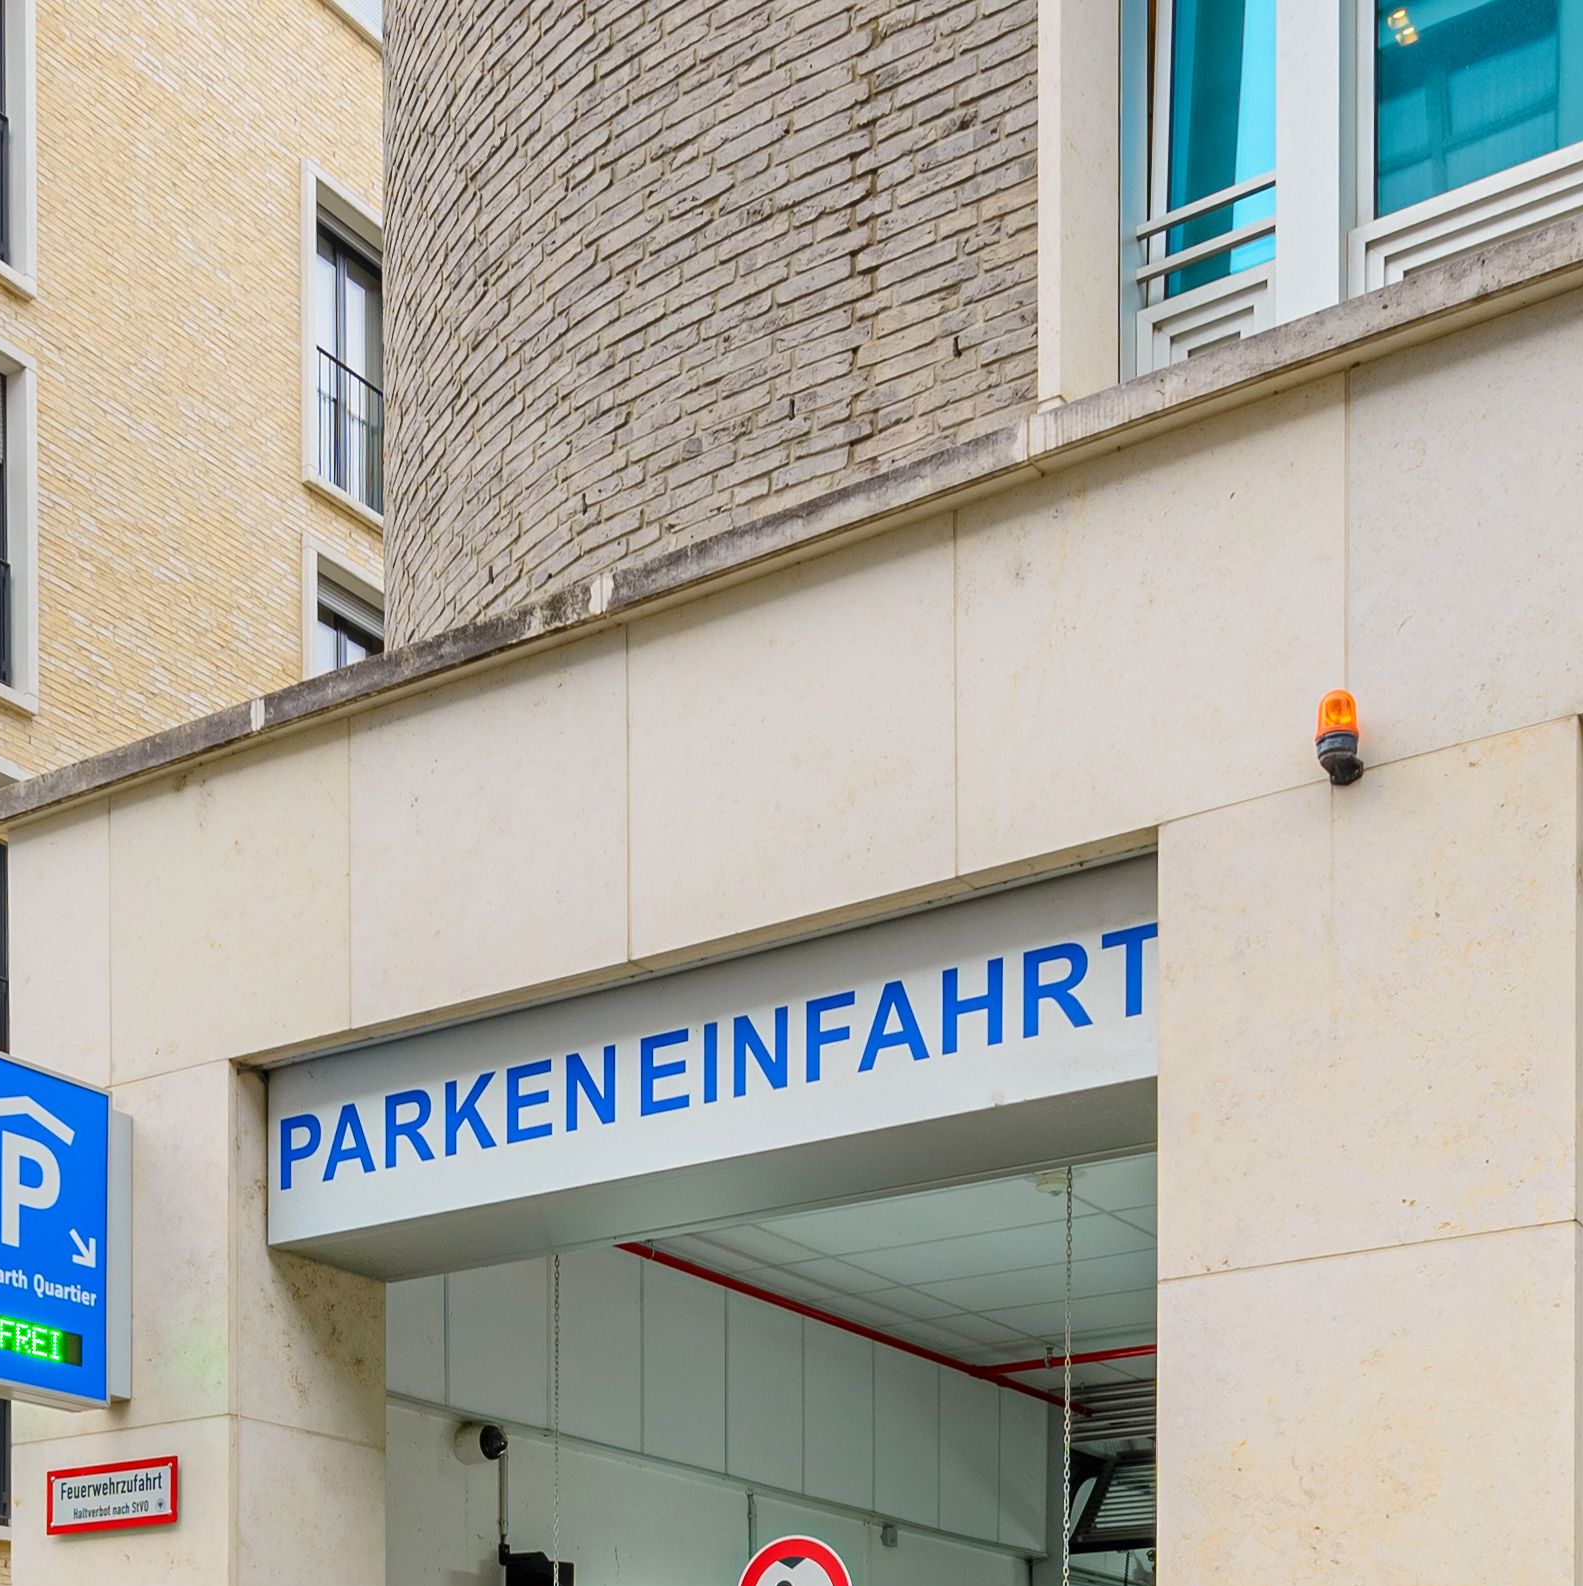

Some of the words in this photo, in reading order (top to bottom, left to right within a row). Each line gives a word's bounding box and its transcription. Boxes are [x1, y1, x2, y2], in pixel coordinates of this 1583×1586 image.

[33, 1273, 97, 1307] Quartier
[60, 1472, 162, 1501] Feuerwehrzufahrt
[73, 1504, 111, 1519] Haltverbot
[112, 1503, 130, 1515] nach
